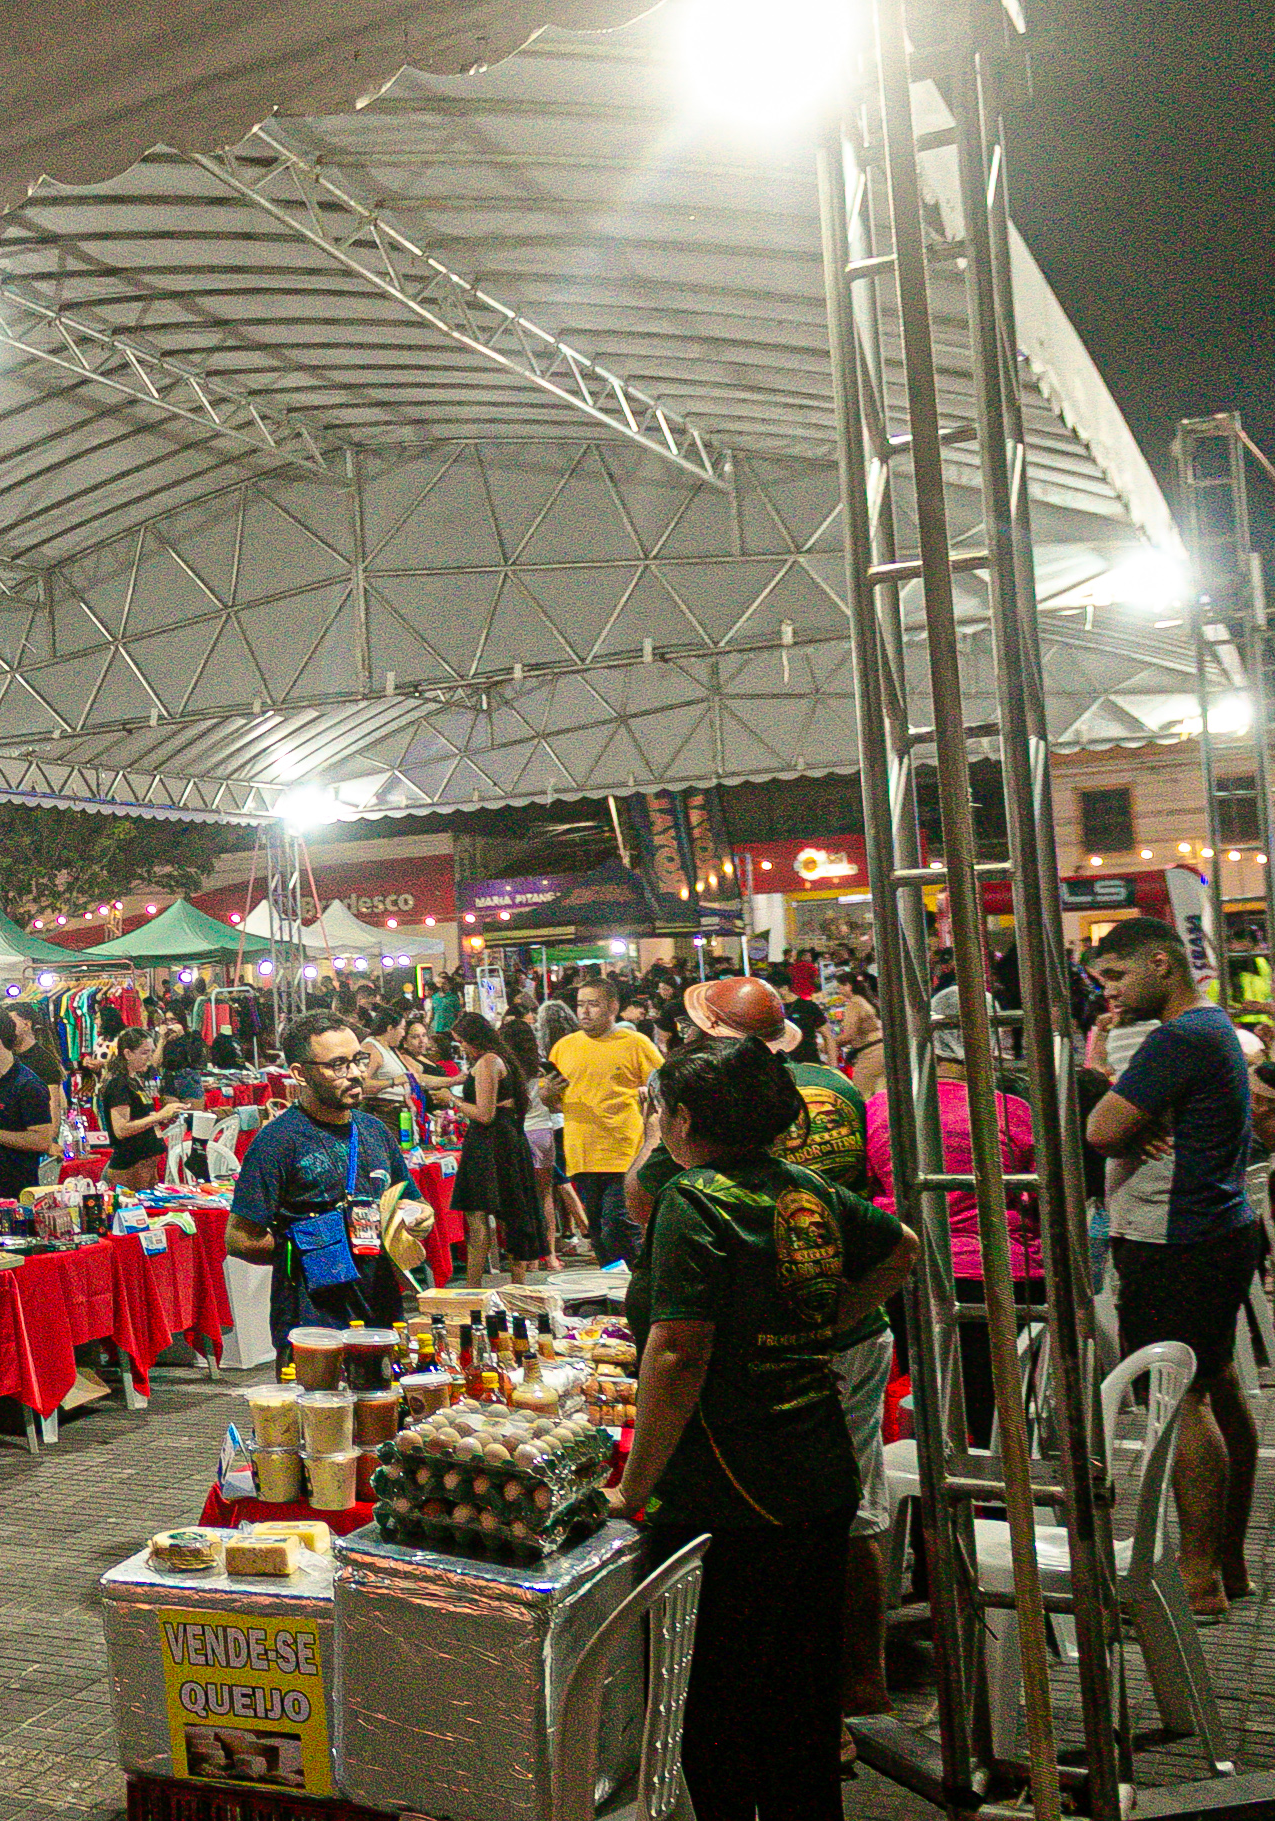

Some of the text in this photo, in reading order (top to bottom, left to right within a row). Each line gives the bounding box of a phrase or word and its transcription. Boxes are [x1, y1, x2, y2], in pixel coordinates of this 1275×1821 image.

[515, 891, 562, 904] PITANG
[163, 1622, 319, 1675] VENDE-SE
[179, 1680, 312, 1724] QUEIJO
